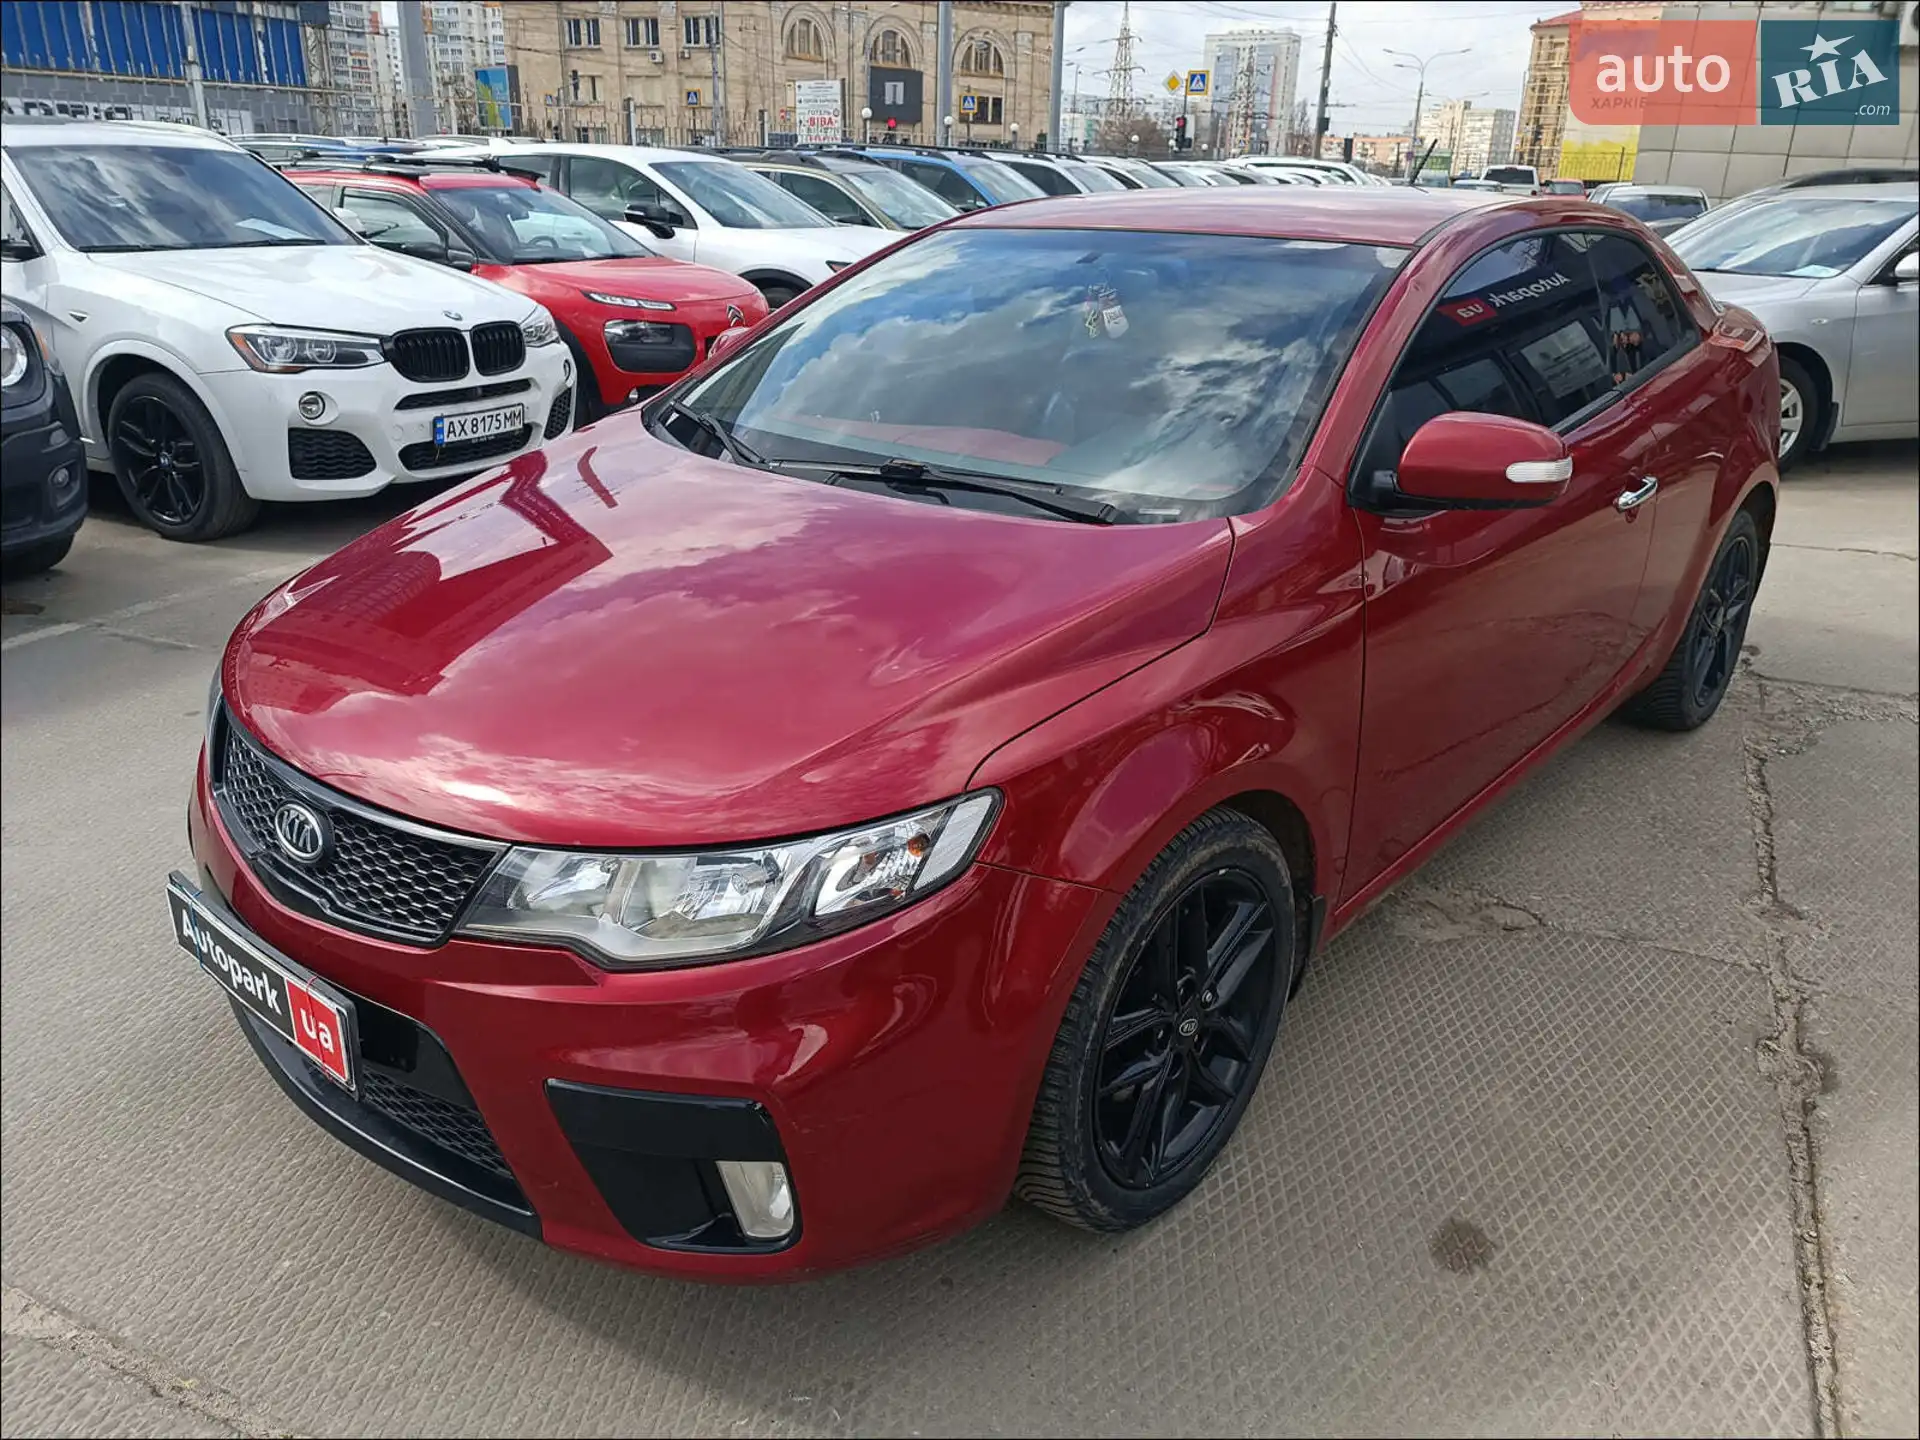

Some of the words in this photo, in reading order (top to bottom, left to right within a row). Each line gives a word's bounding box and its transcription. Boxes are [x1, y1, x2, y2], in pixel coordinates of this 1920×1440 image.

[446, 419, 468, 439] AX
[471, 413, 501, 434] 8175
[503, 408, 522, 429] MM
[181, 908, 283, 1016] Autopark
